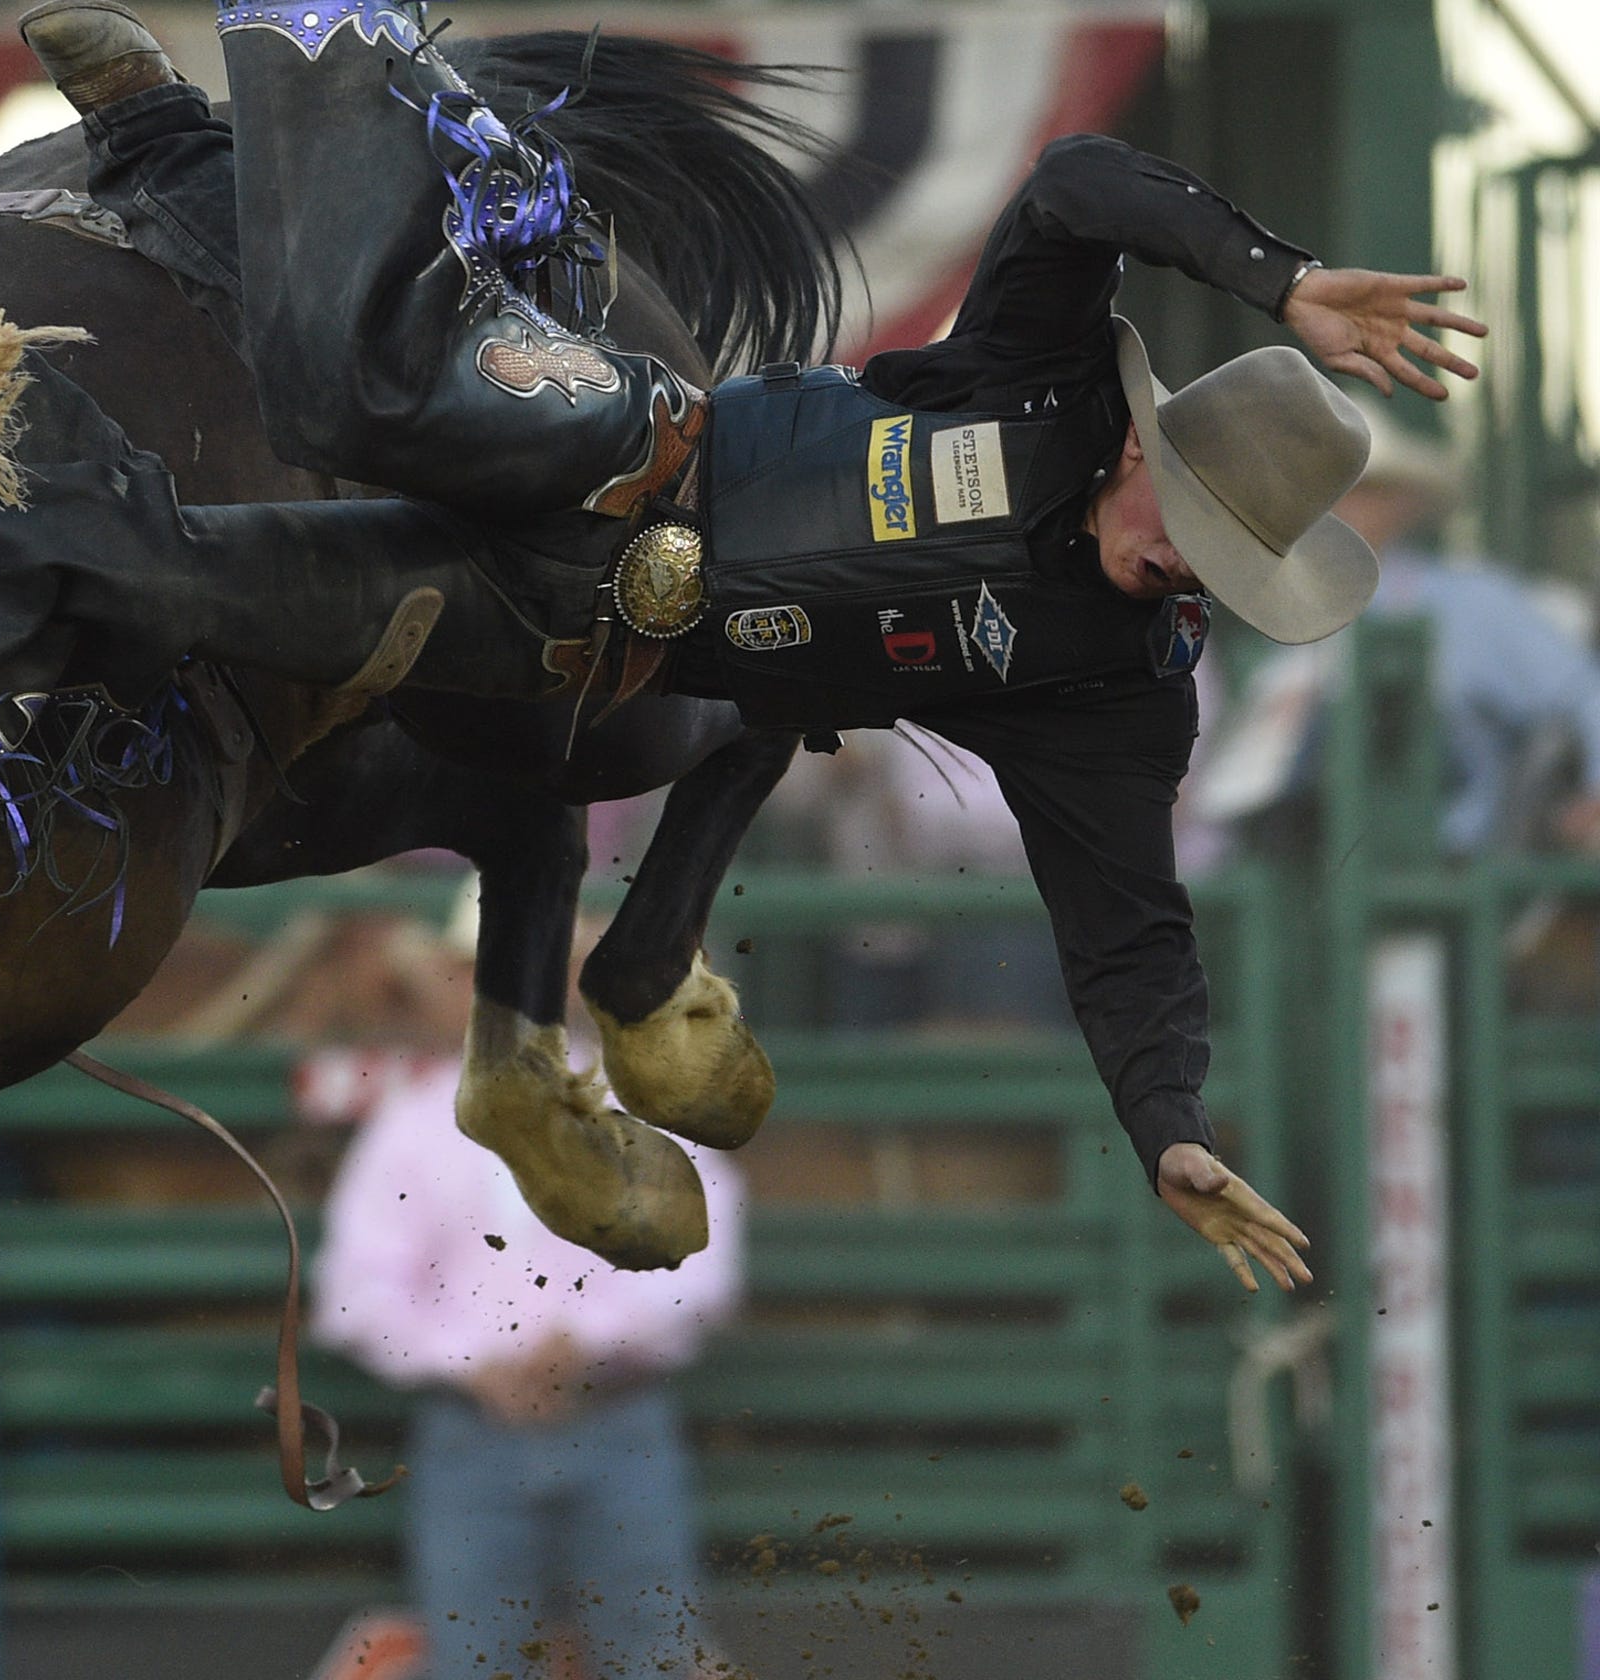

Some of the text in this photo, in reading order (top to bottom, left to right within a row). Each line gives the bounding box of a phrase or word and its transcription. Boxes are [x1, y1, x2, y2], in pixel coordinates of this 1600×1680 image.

[871, 418, 910, 532] Wrangler
[952, 440, 966, 508] LEGENDARY HATS
[962, 429, 984, 516] STETSON
[877, 609, 936, 664] the D
[984, 618, 1003, 652] PDI
